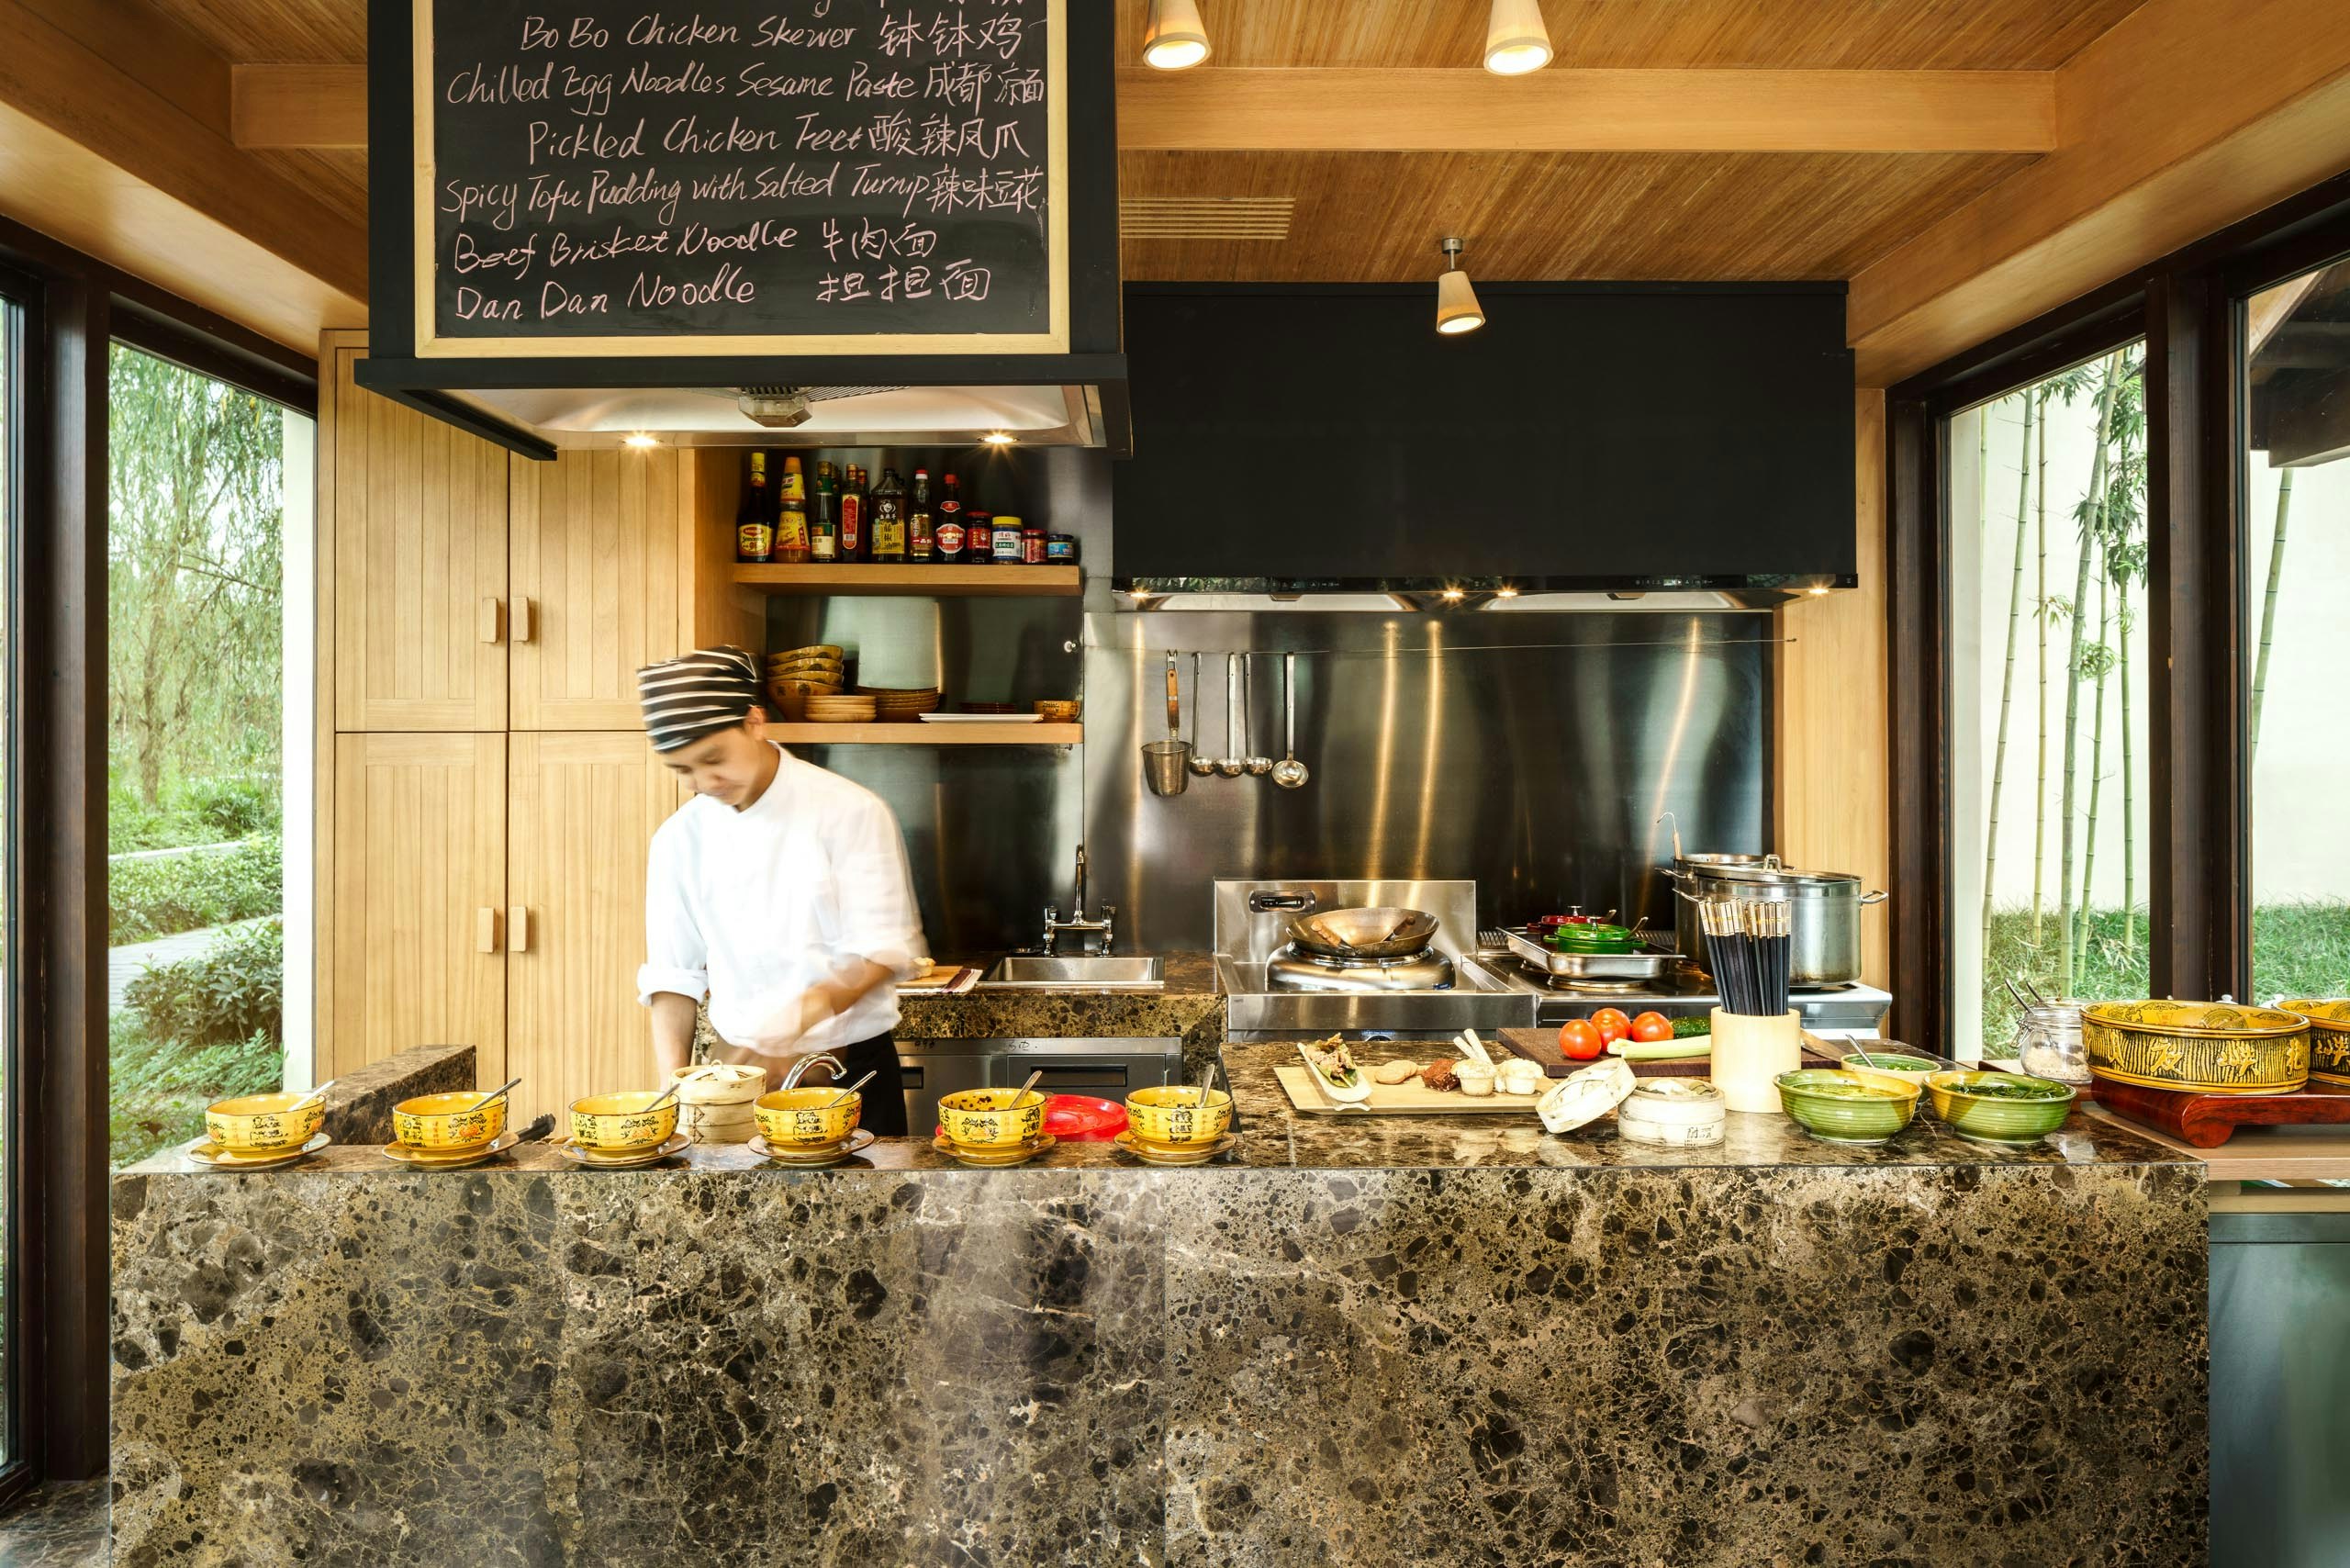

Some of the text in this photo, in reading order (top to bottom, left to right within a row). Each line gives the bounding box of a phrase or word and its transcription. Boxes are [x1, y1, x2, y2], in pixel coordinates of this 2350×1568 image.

[520, 15, 559, 50] Bo
[568, 17, 610, 49] Bo
[626, 13, 741, 47] Chicken
[751, 15, 857, 49] Skewer
[447, 62, 554, 104] Chilled
[561, 65, 613, 116] Egg
[620, 60, 726, 95] Noodles
[736, 61, 834, 98] Sesame
[845, 61, 918, 102] Paste
[529, 108, 1031, 166] Pickled Chicken Feet 酸辣凤爪
[441, 178, 519, 231] Spicy
[527, 174, 582, 223] Tofu
[587, 169, 682, 226] Pudding
[691, 166, 748, 201] with
[750, 161, 841, 201] Salted
[850, 162, 931, 218] Turnip
[453, 217, 937, 280] Beef Brisket Noodle 牛肉面
[455, 285, 523, 321] Dan
[540, 280, 609, 320] Dan
[627, 262, 756, 308] Noodle
